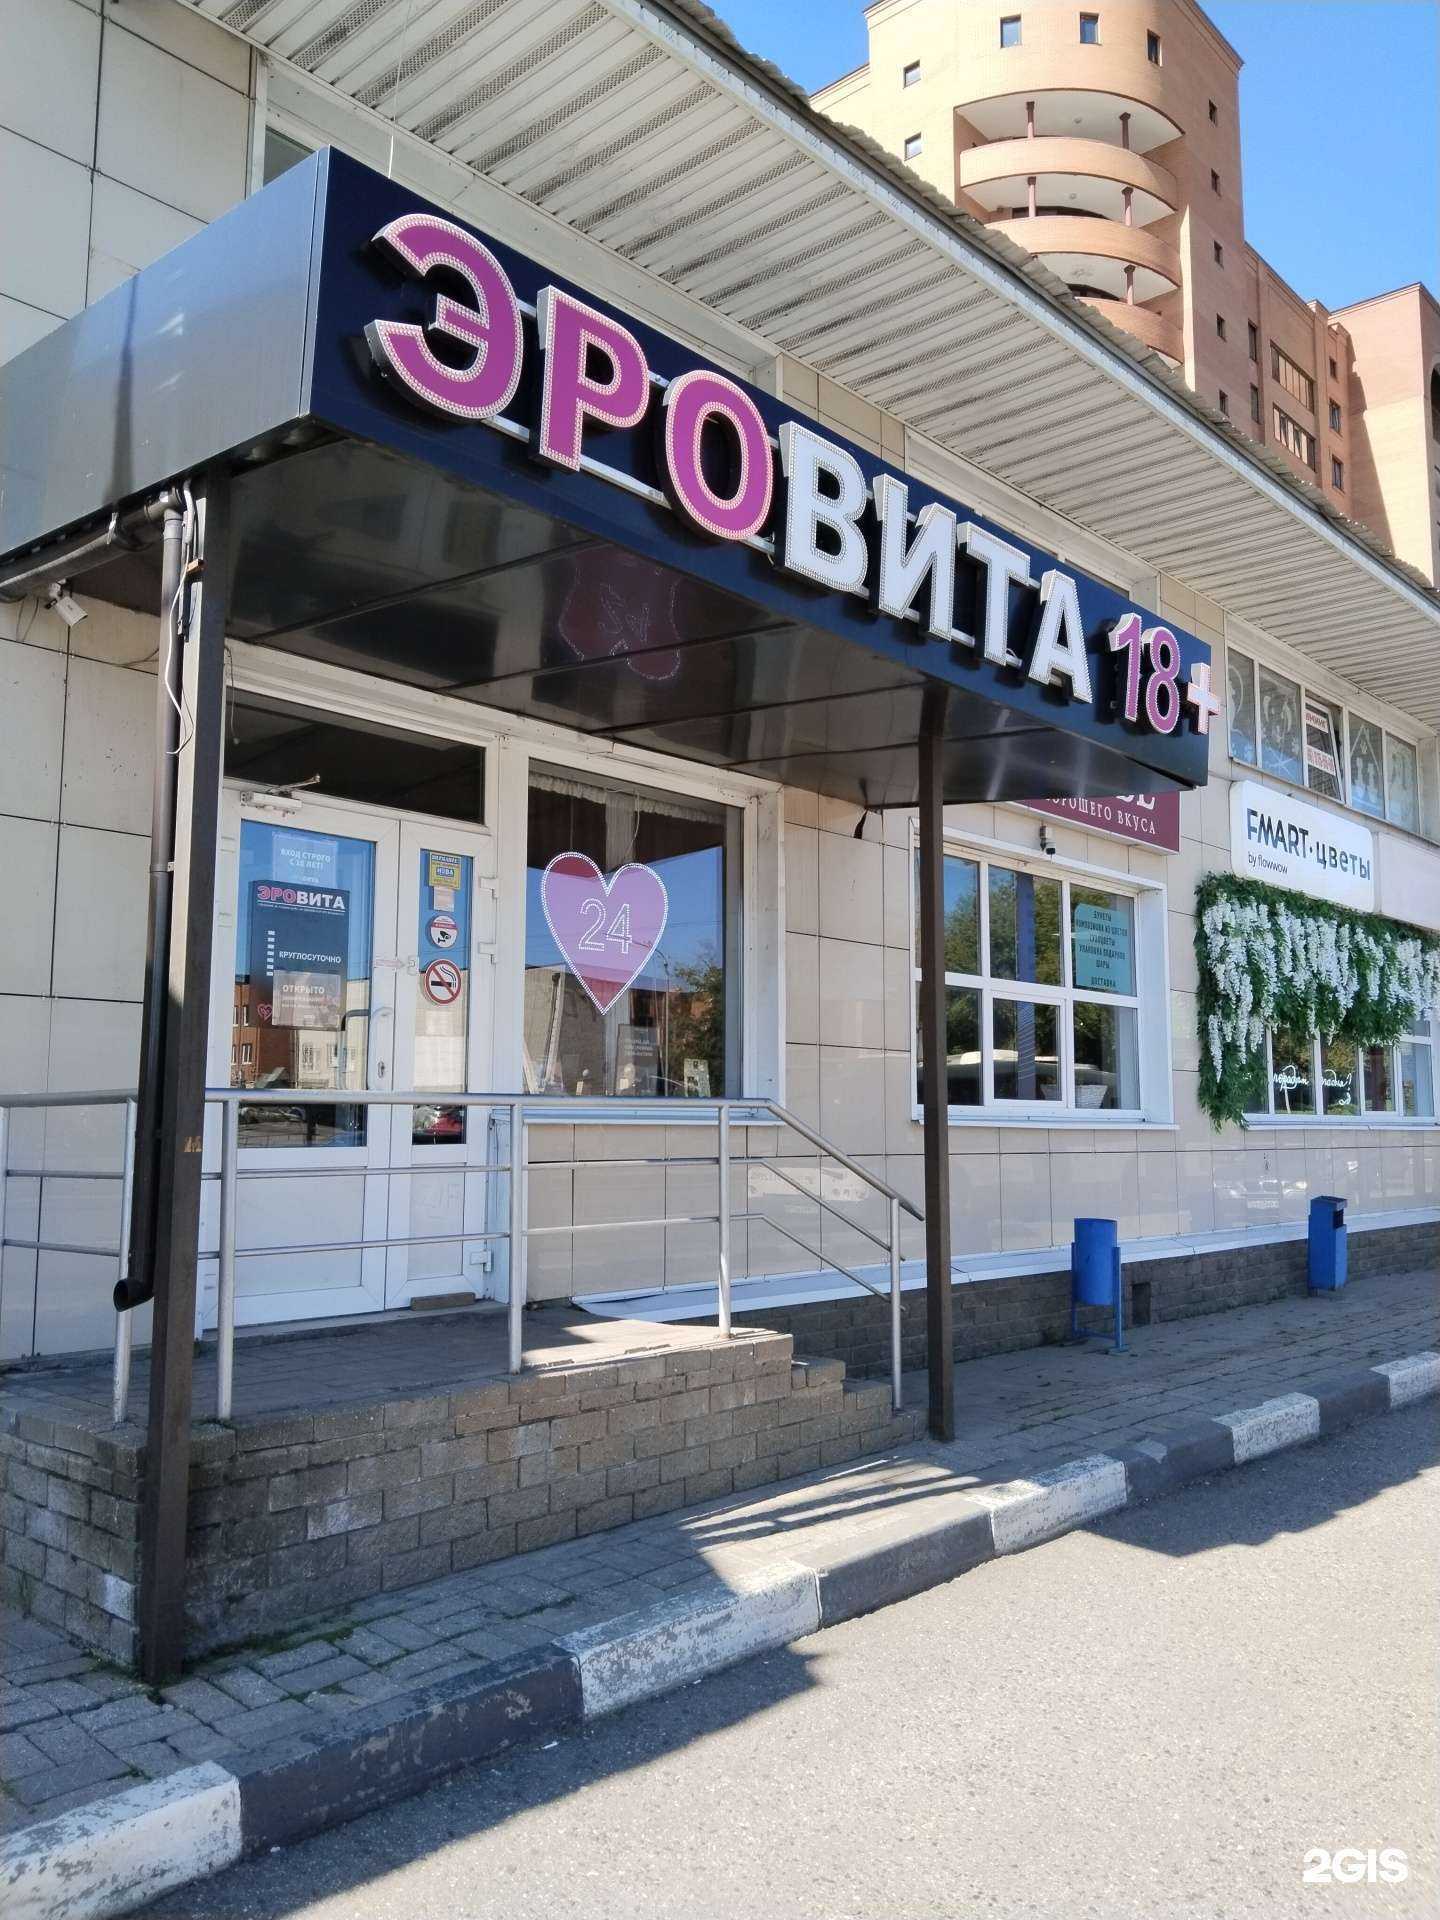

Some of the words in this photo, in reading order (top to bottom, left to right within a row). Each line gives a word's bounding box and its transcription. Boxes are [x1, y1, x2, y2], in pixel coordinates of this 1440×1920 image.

[364, 213, 1093, 703] ЭРОВИТА
[1109, 611, 1221, 735] 18+
[1045, 796, 1112, 820] РОШЕГО
[1118, 811, 1155, 834] ВКУСА
[1248, 851, 1257, 867] by
[257, 885, 346, 910] ЭРОВИТА
[578, 898, 632, 954] 24
[279, 951, 342, 964] КРУГЛОСУТОЧНО
[282, 984, 326, 995] ОТКРЫТО
